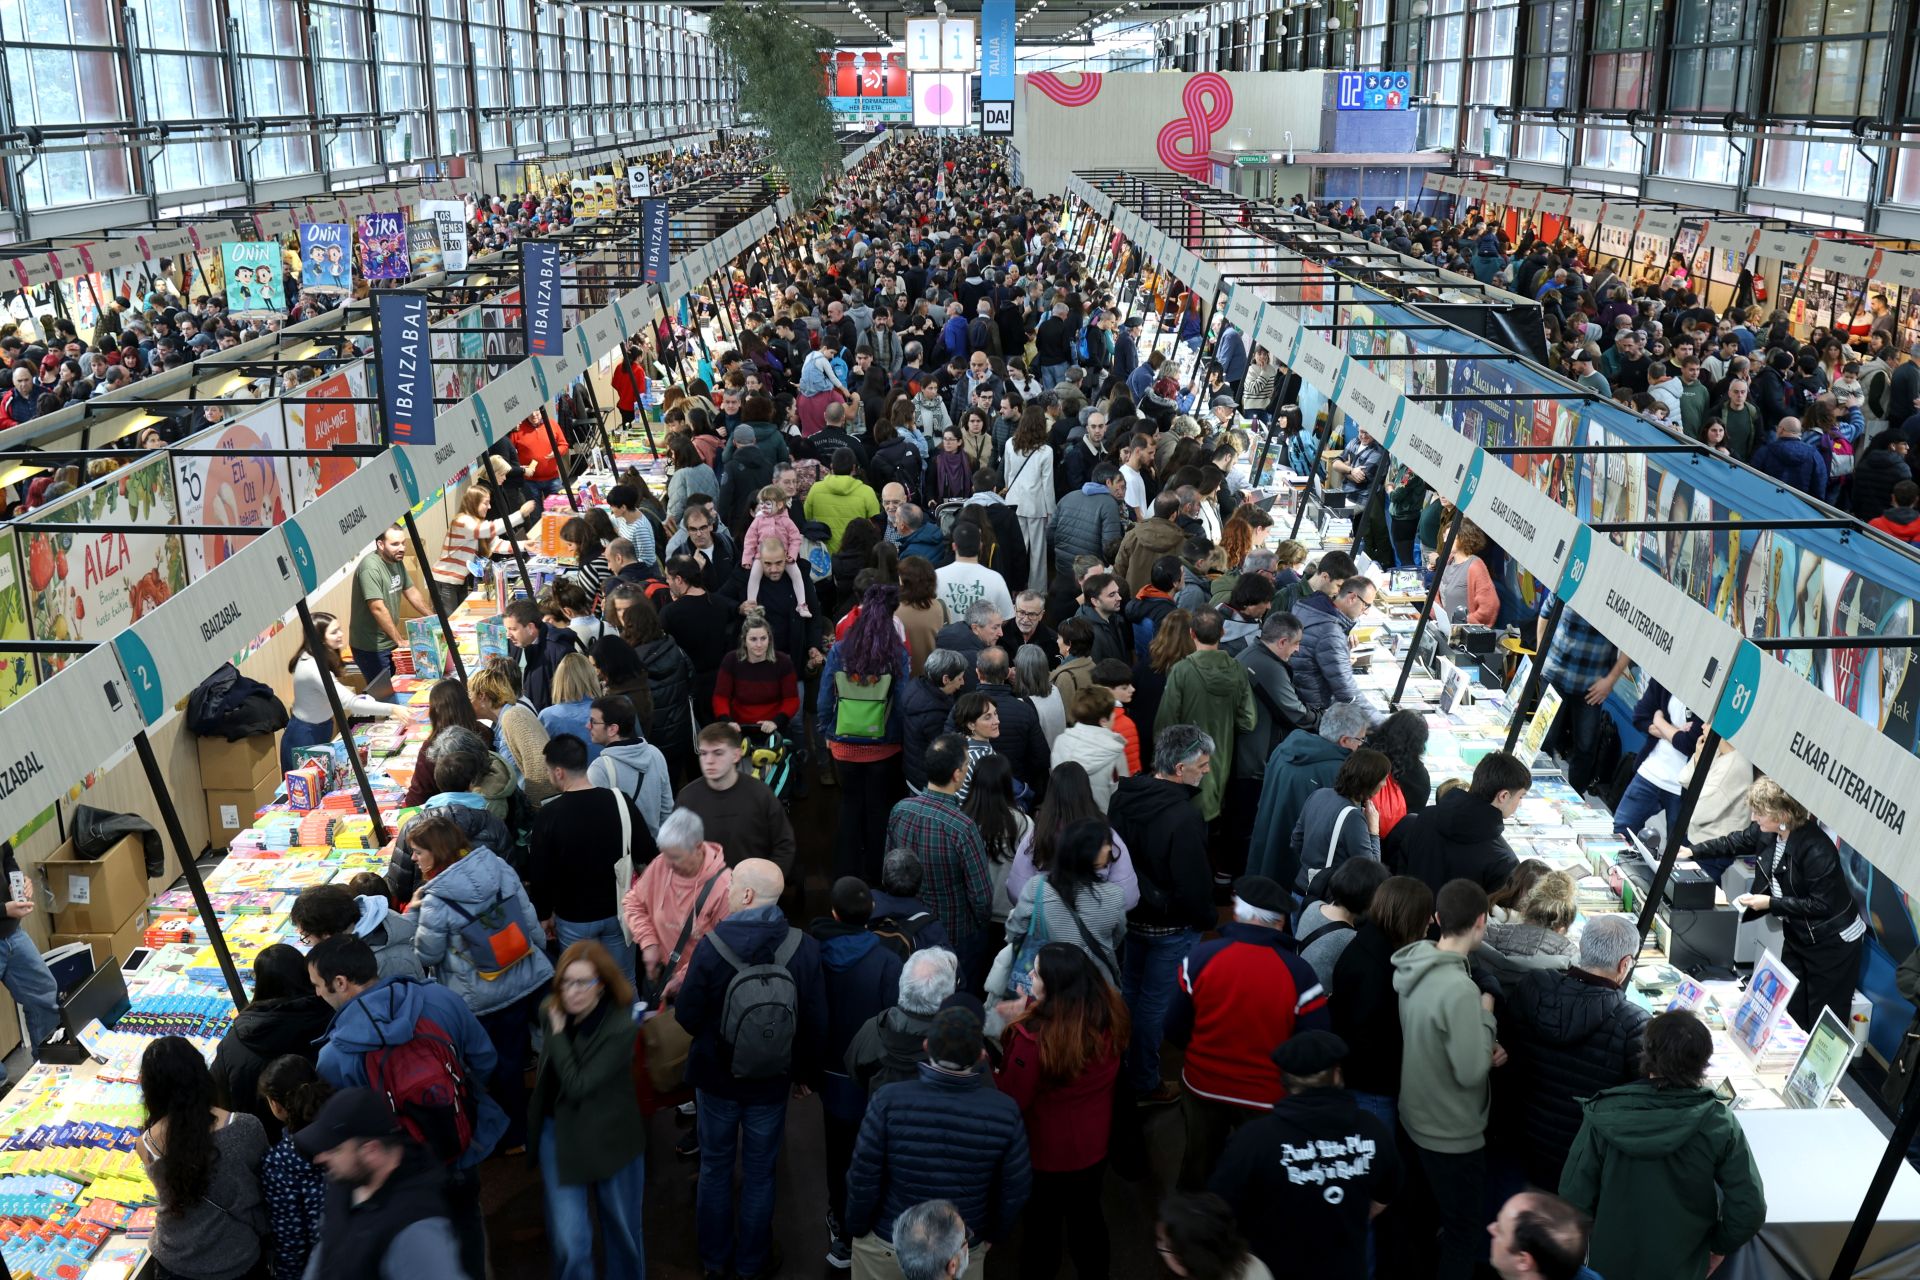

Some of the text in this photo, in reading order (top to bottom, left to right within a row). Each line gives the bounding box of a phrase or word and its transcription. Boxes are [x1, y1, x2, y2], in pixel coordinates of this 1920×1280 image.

[989, 37, 1000, 77] TALAIA
[1341, 76, 1362, 106] 02
[1374, 94, 1384, 104] P
[986, 109, 1010, 124] DA!
[412, 231, 433, 241] ALMA
[412, 240, 437, 251] NEGRA
[648, 201, 667, 268] IBAIZABAL
[534, 246, 556, 335] IBAIZABAL
[395, 299, 422, 418] IBAIZABAL
[1409, 433, 1444, 469] ELKAR LITERATURA
[405, 468, 413, 484] 4
[1466, 474, 1478, 495] 79
[338, 504, 368, 536] IBAIZABAL
[1490, 496, 1537, 544] ELKAR LITERATURA
[84, 531, 131, 590] AIZA
[297, 546, 308, 567] 3
[1570, 558, 1585, 582] 80
[199, 600, 242, 643] IBAIZABAL
[1605, 588, 1676, 656] ELKAR LITERATURA
[138, 664, 153, 692] 2
[1731, 683, 1752, 714] 81
[1789, 730, 1907, 836] ELKAR LITERATURA
